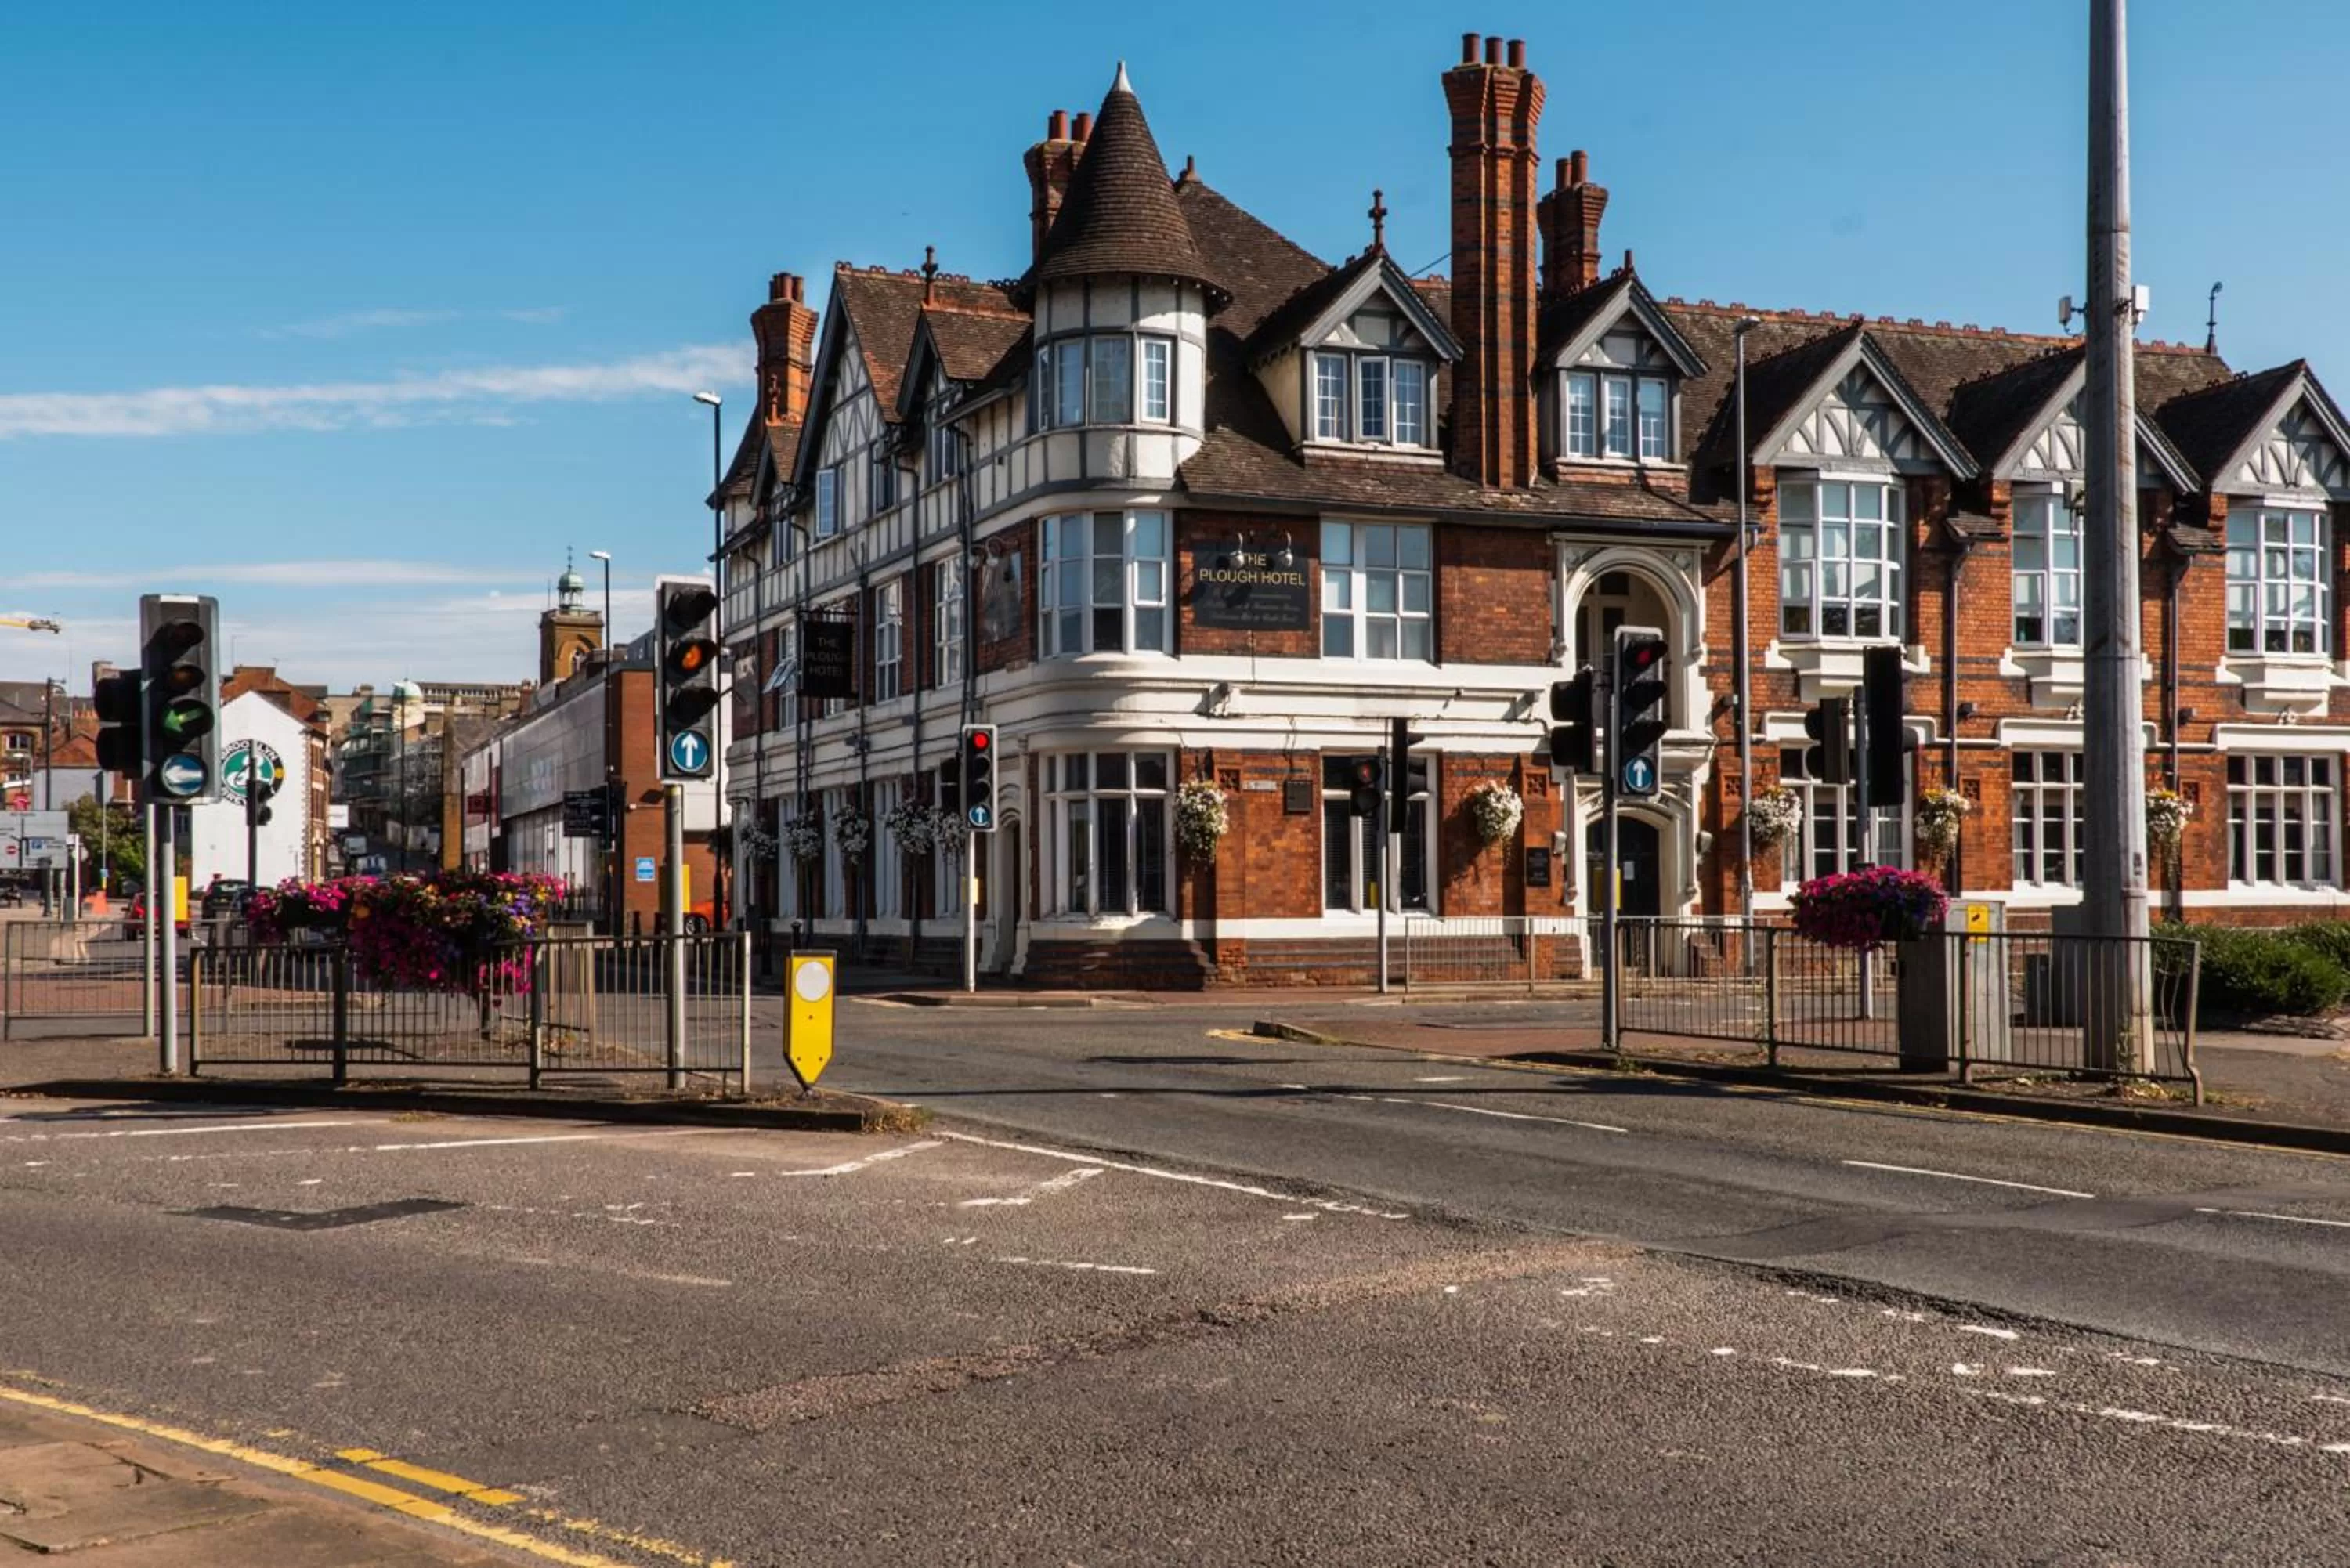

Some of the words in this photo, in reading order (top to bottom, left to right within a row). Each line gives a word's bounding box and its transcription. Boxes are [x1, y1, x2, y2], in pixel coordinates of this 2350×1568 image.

[1242, 552, 1267, 566] THE
[1199, 568, 1258, 583] PLOUGH
[1261, 571, 1306, 587] HOTEL
[816, 636, 840, 649] THE
[804, 651, 848, 663] PLOUG
[808, 665, 844, 677] HOTEL
